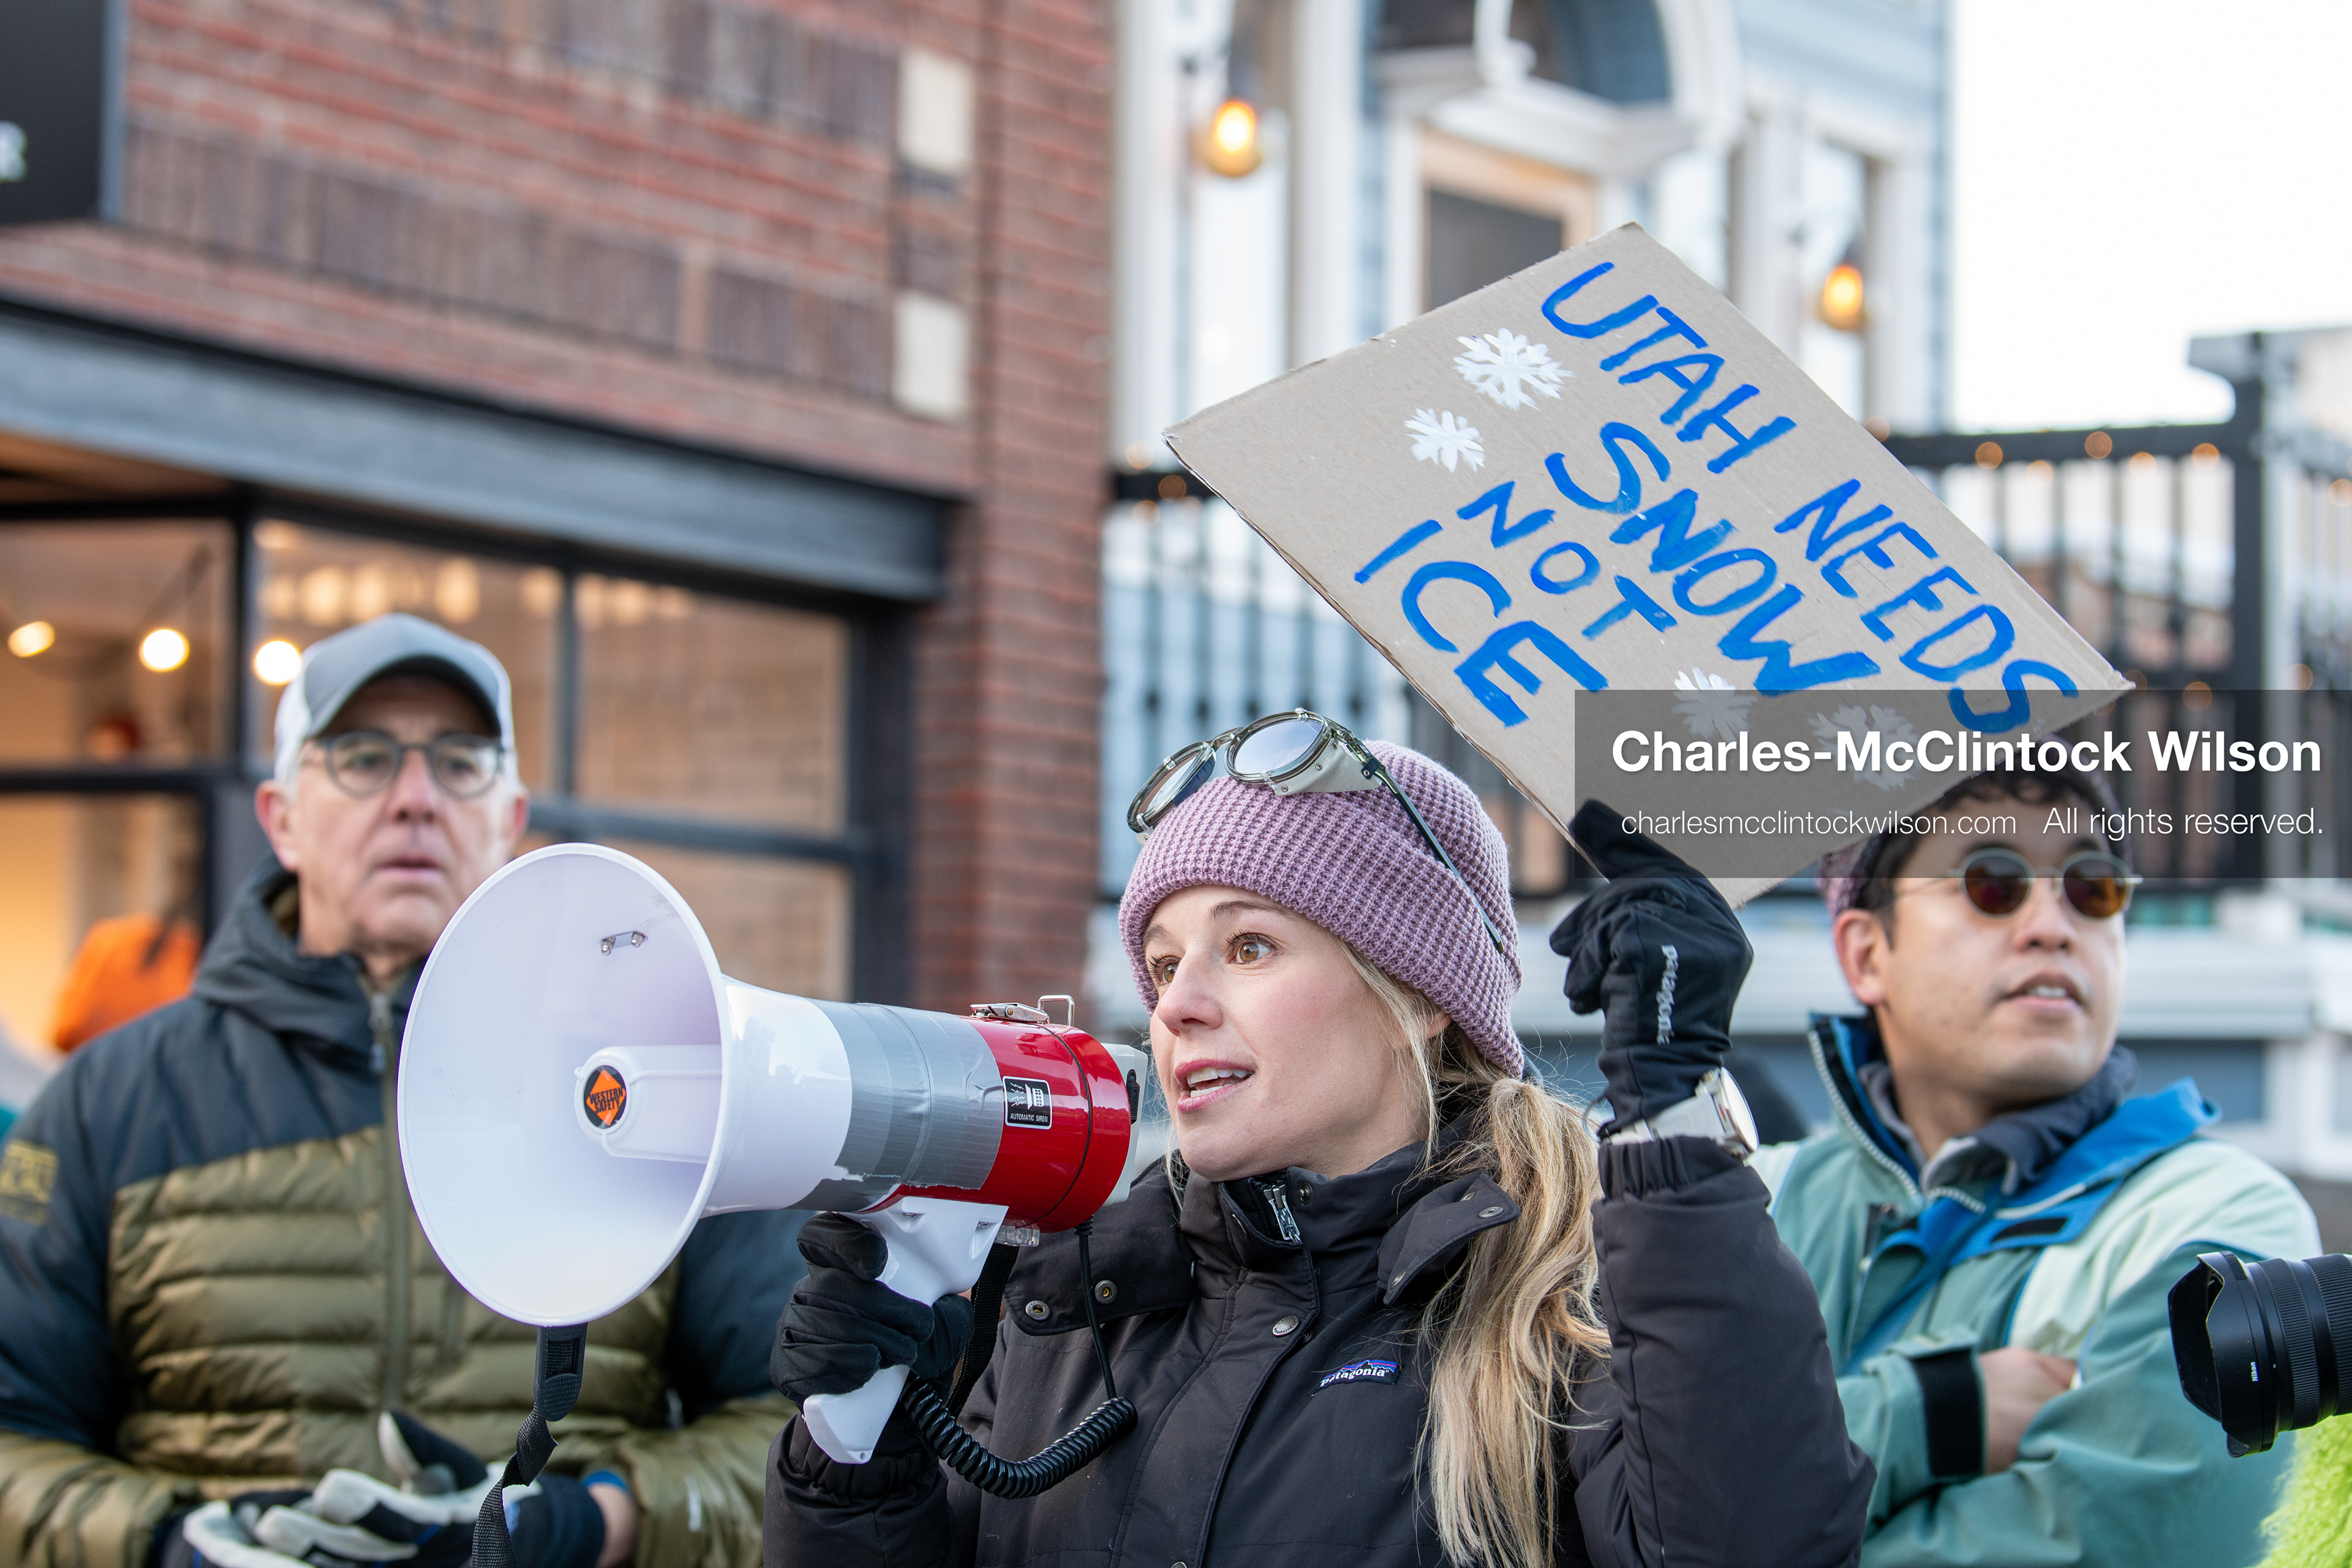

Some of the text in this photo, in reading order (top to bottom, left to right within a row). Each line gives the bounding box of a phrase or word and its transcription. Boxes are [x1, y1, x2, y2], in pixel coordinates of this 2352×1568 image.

[1456, 481, 1678, 640] NOT
[1541, 262, 2079, 734] UTAH NEEDS
[1544, 421, 1882, 698] SNOW
[1354, 519, 1610, 728] ICE
[589, 1087, 623, 1104] WESTERN
[594, 1099, 620, 1113] SAFETY
[2250, 1362, 2259, 1381] Nikon
